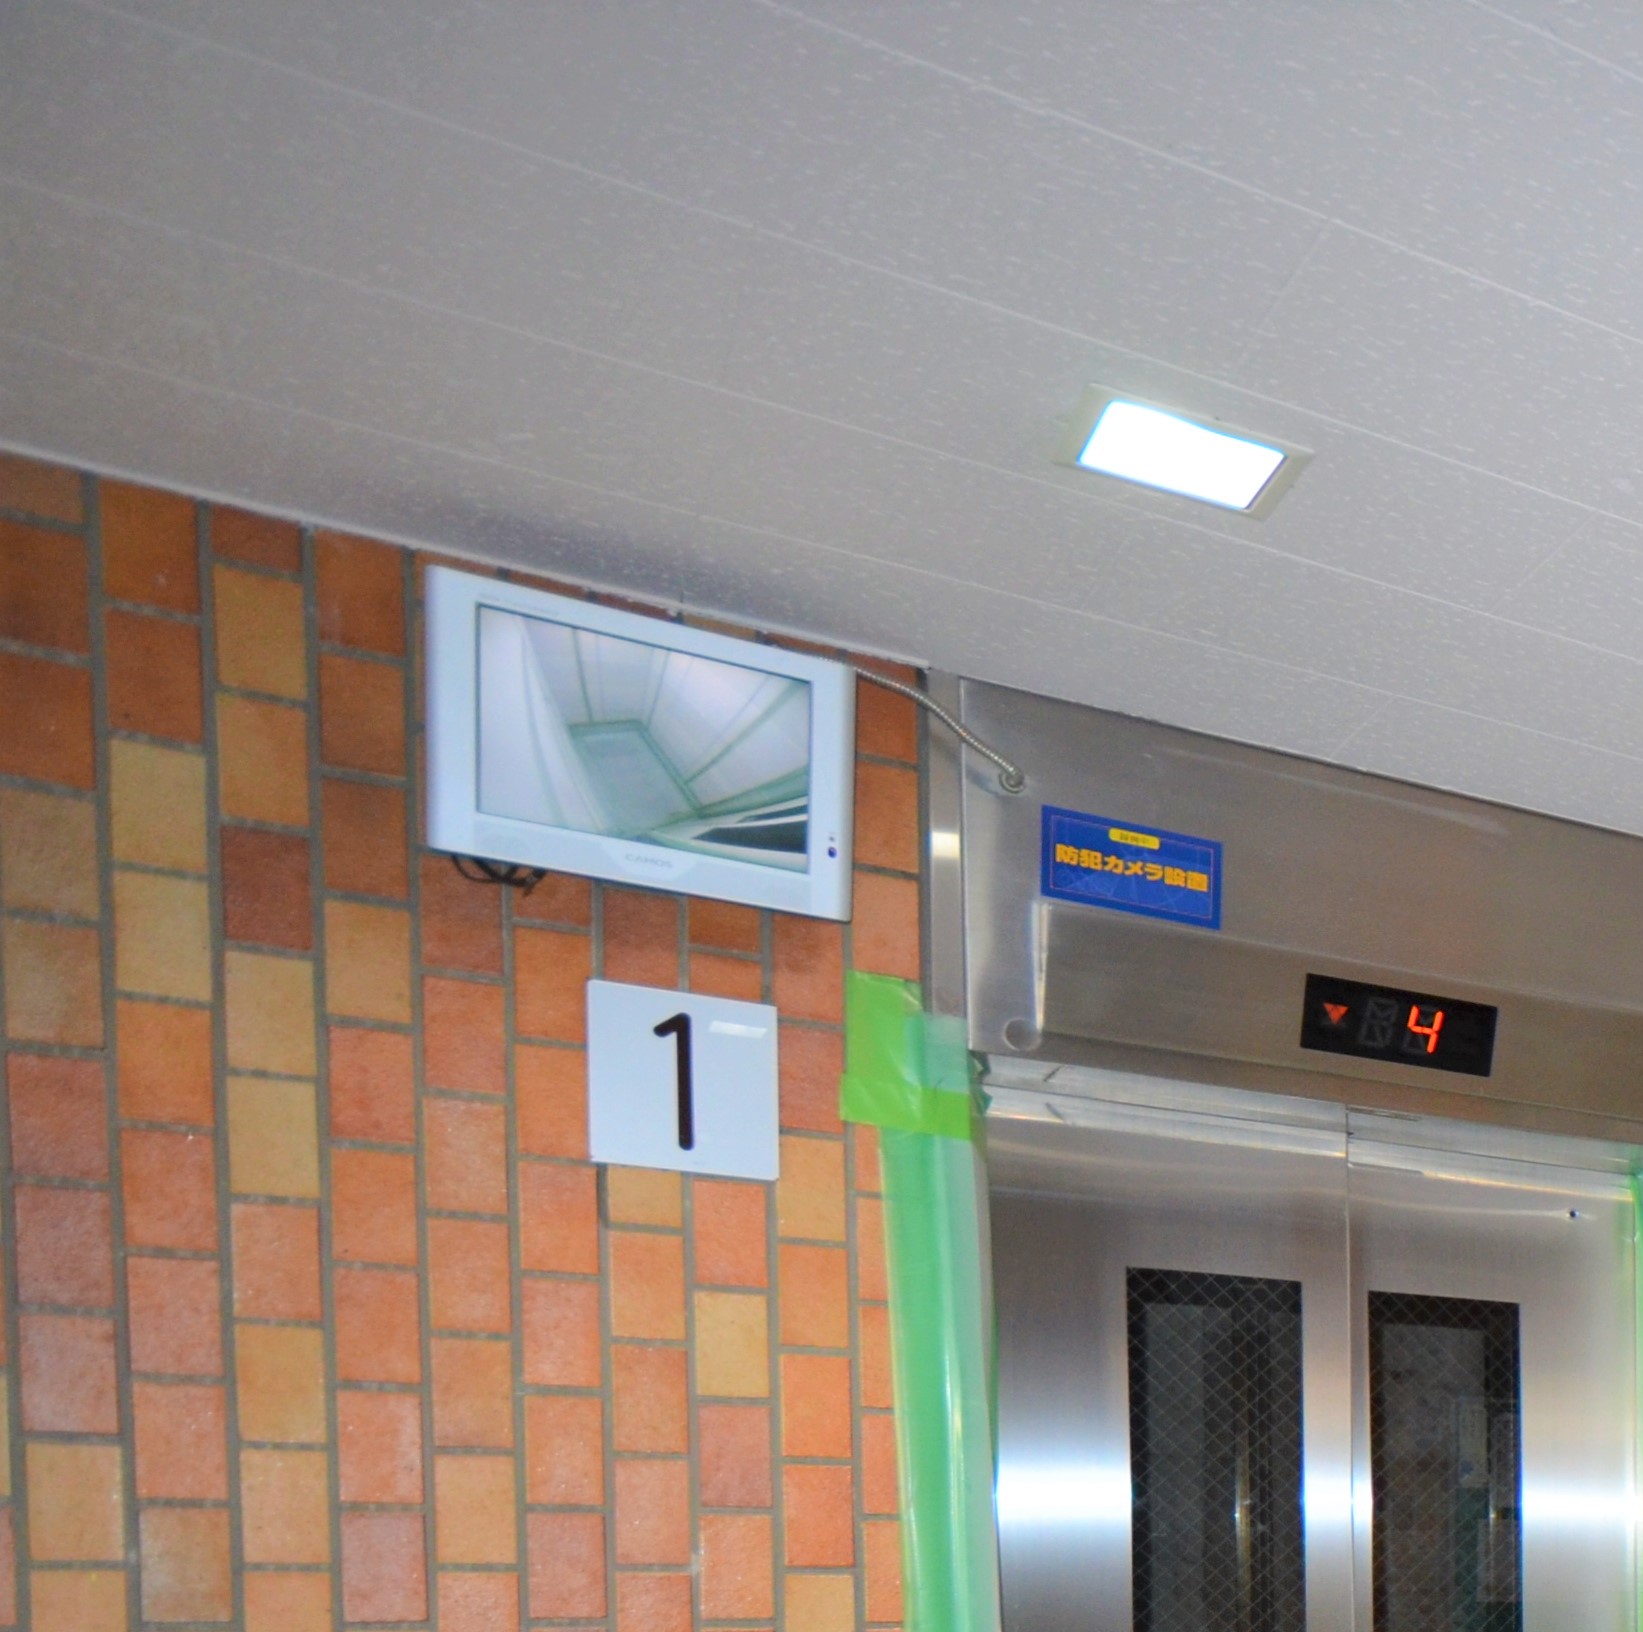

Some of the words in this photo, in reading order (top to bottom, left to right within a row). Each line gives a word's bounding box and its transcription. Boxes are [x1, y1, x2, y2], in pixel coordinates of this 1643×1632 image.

[1055, 843, 1209, 893] 防犯カメラ設置
[1407, 1004, 1444, 1054] 4
[652, 1012, 693, 1152] 1
